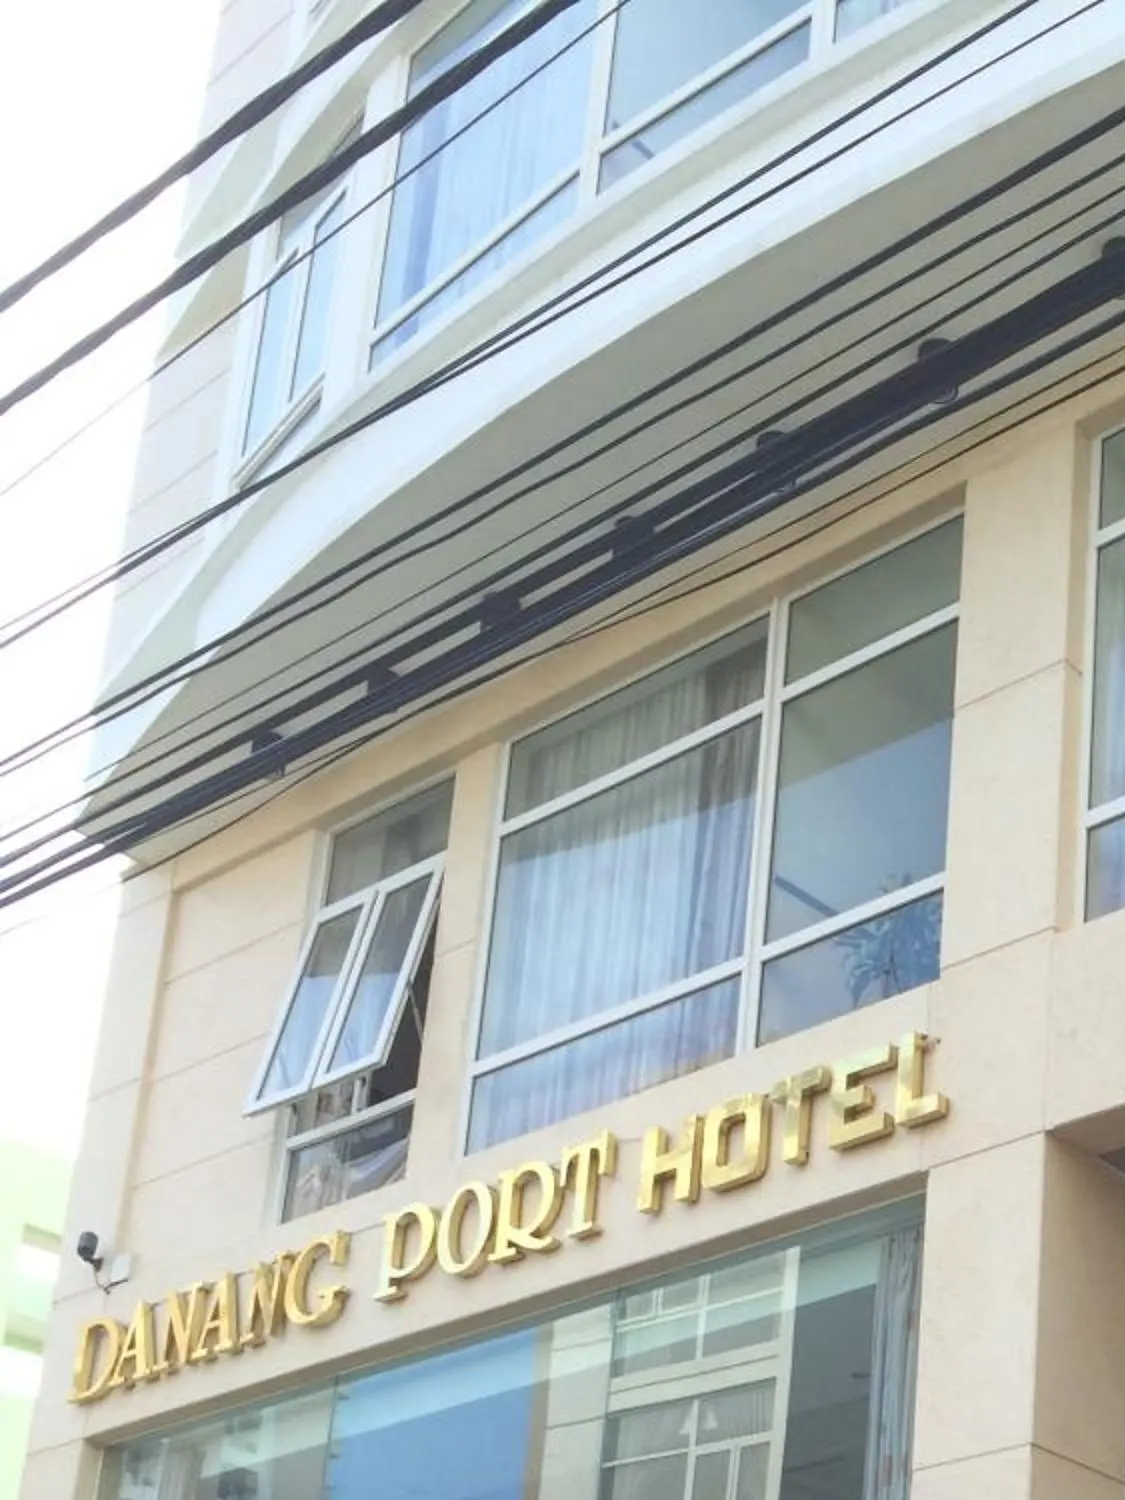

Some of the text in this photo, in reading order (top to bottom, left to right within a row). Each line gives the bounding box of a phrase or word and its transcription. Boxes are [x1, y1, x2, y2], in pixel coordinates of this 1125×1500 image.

[67, 1031, 949, 1406] DANANG PORT HOTEL
